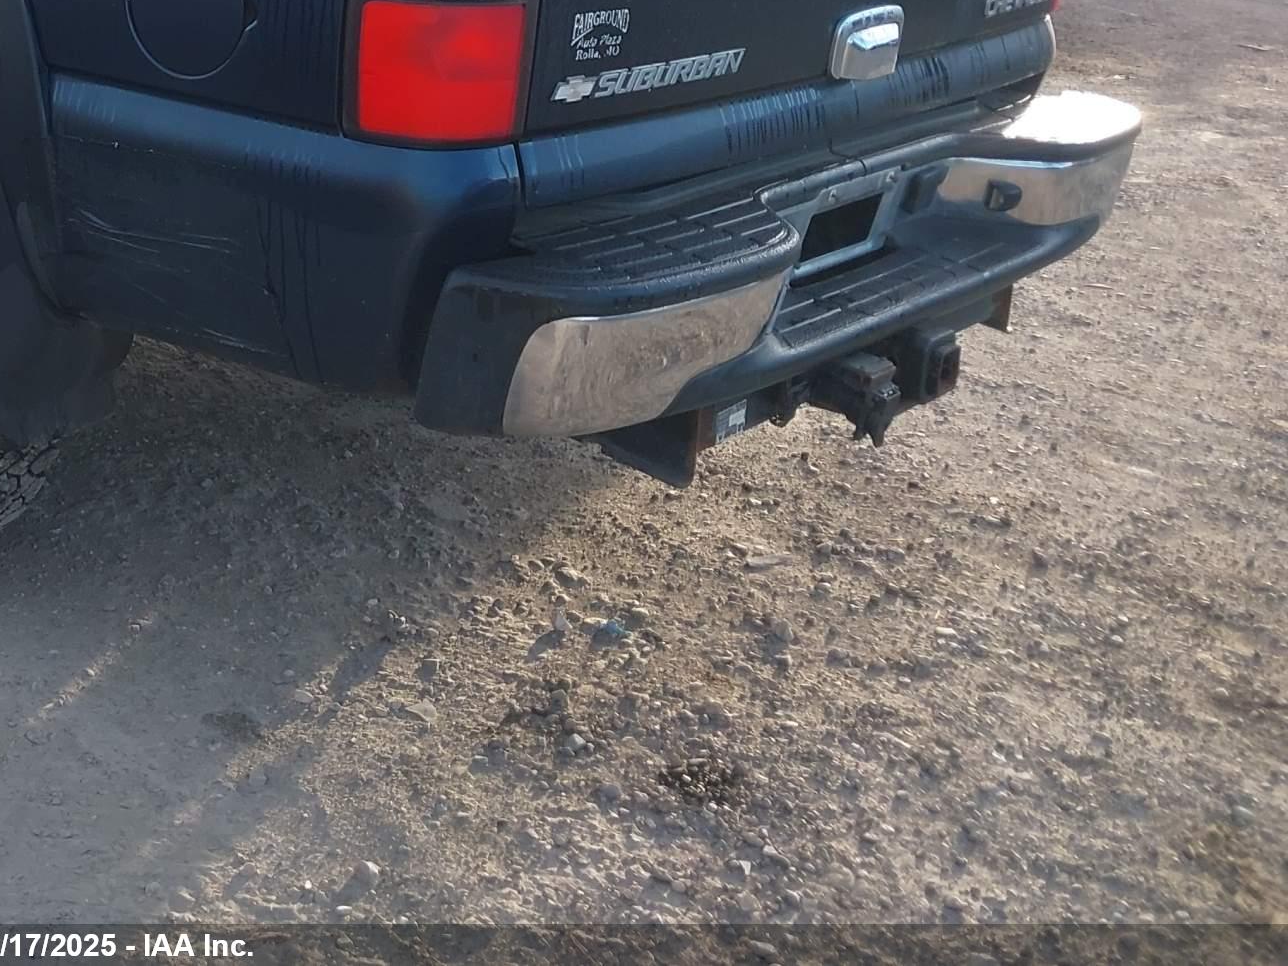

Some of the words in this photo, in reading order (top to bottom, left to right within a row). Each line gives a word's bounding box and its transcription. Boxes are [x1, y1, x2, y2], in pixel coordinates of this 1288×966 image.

[571, 8, 630, 40] FAIRGROUND
[576, 36, 598, 49] Auto
[599, 33, 622, 46] Plaza
[594, 47, 747, 98] SUBURBAN
